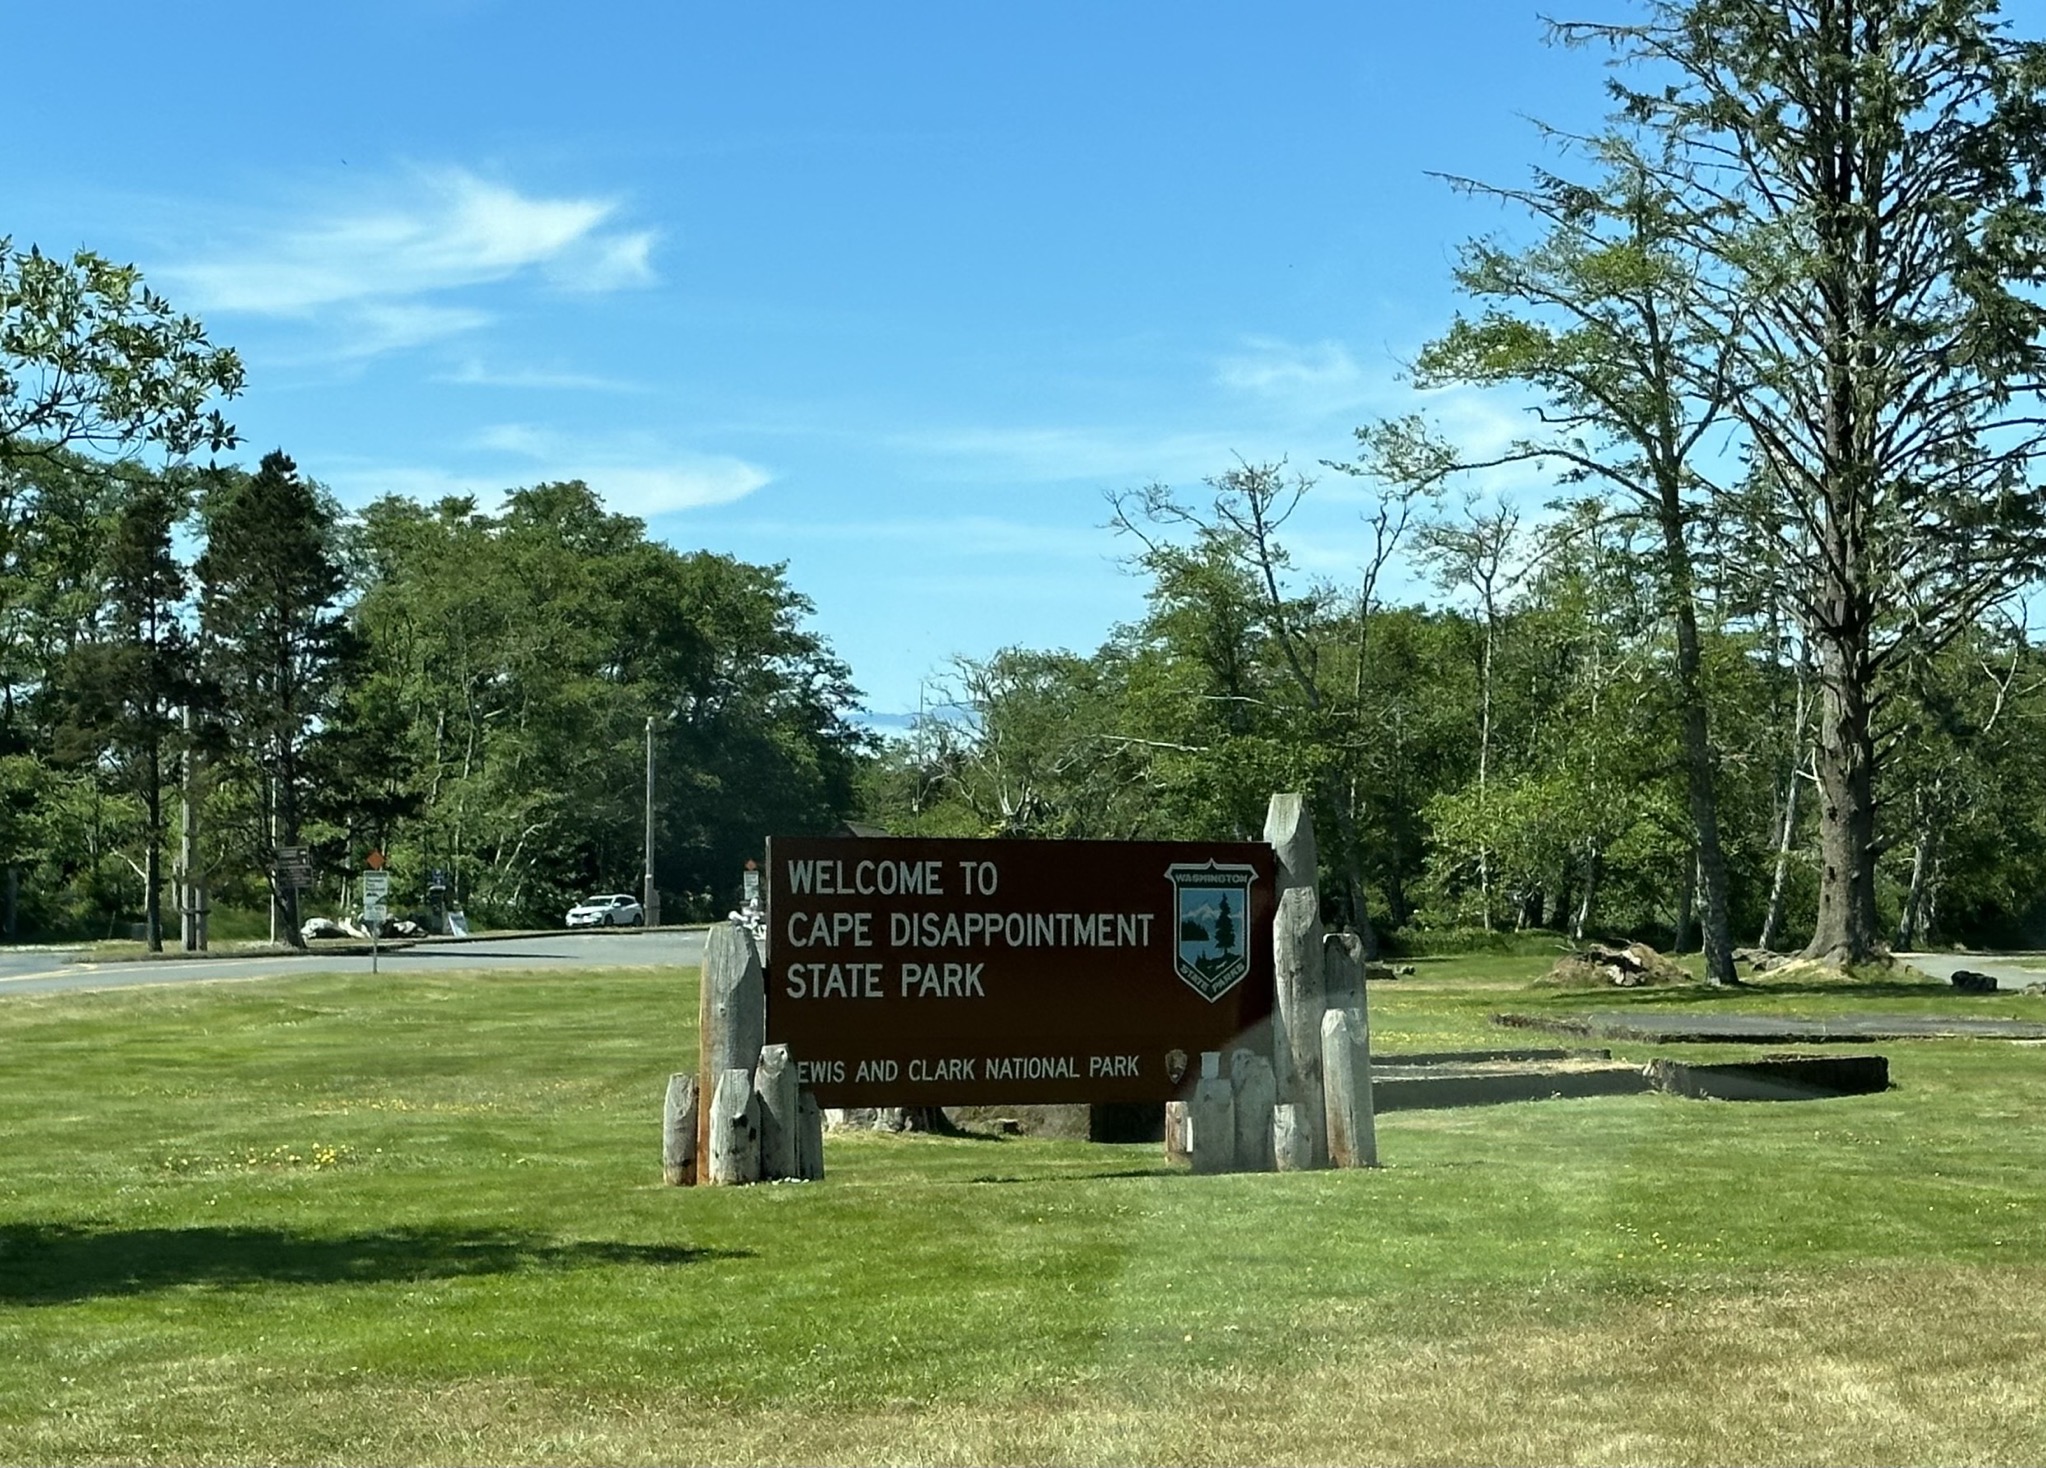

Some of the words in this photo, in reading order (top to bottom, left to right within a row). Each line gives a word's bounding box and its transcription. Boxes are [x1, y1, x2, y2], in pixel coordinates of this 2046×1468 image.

[788, 860, 943, 895] WELCOME
[959, 860, 998, 895] TO
[1175, 873, 1248, 884] WASHINGTON
[787, 912, 872, 947] CAPE
[890, 912, 1154, 947] DISAPPOINTMENT
[786, 963, 883, 998] STATE
[901, 962, 985, 998] PARK
[1179, 964, 1210, 992] STATE
[1212, 962, 1246, 993] PARKS
[797, 1060, 845, 1083] EWIS
[855, 1059, 898, 1082] AND
[908, 1057, 975, 1081] CLARK
[985, 1055, 1080, 1079] NATIONAL
[1089, 1054, 1140, 1077] PARK
